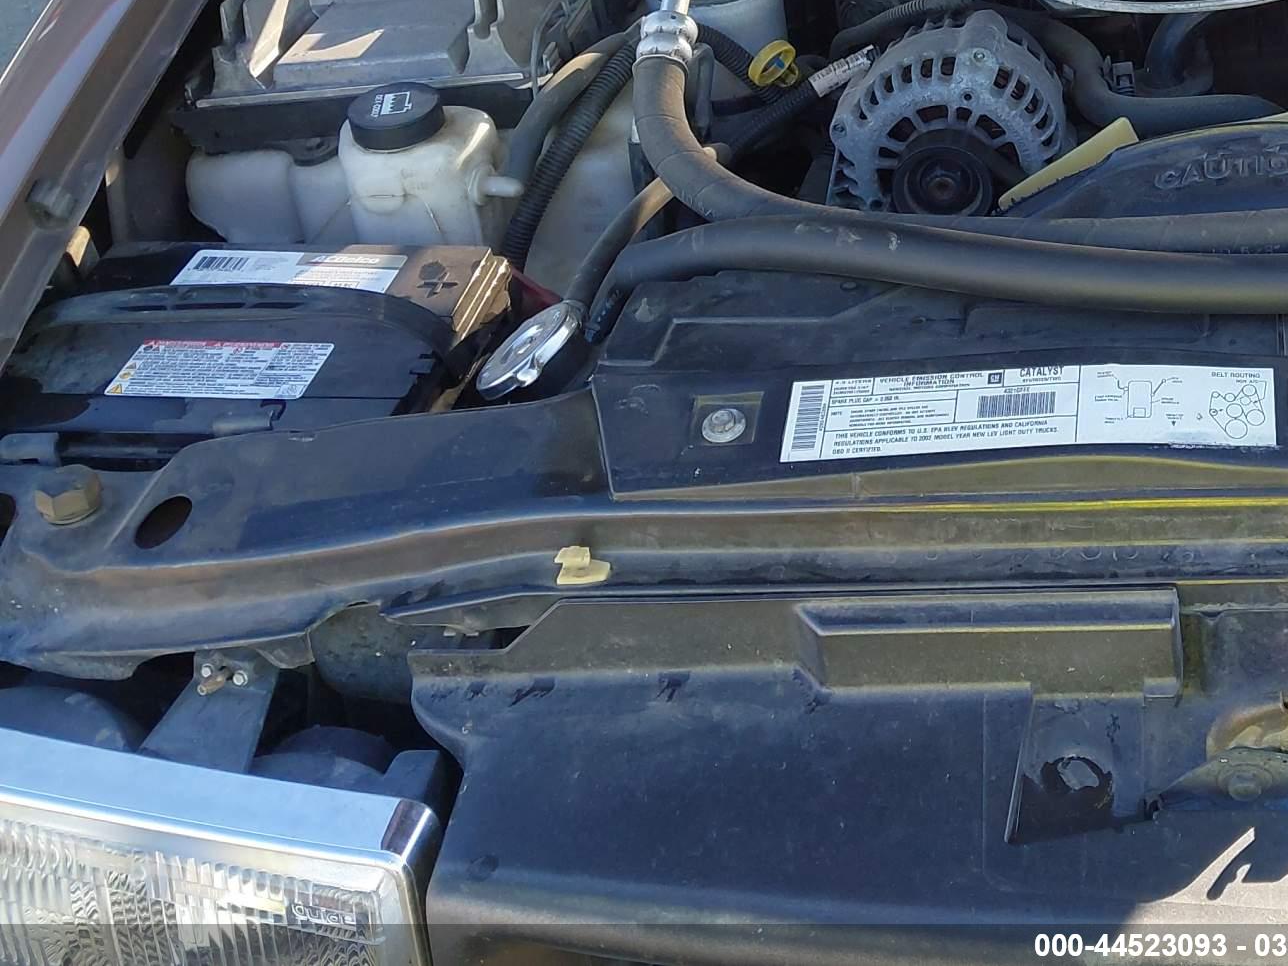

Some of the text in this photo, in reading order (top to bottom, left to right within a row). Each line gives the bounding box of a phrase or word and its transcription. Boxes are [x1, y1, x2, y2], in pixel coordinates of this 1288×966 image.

[1019, 366, 1064, 378] CATALYST
[874, 429, 906, 437] CONFORMS
[959, 423, 999, 431] REGULATIONS
[1014, 420, 1048, 428] CALIFORNIA
